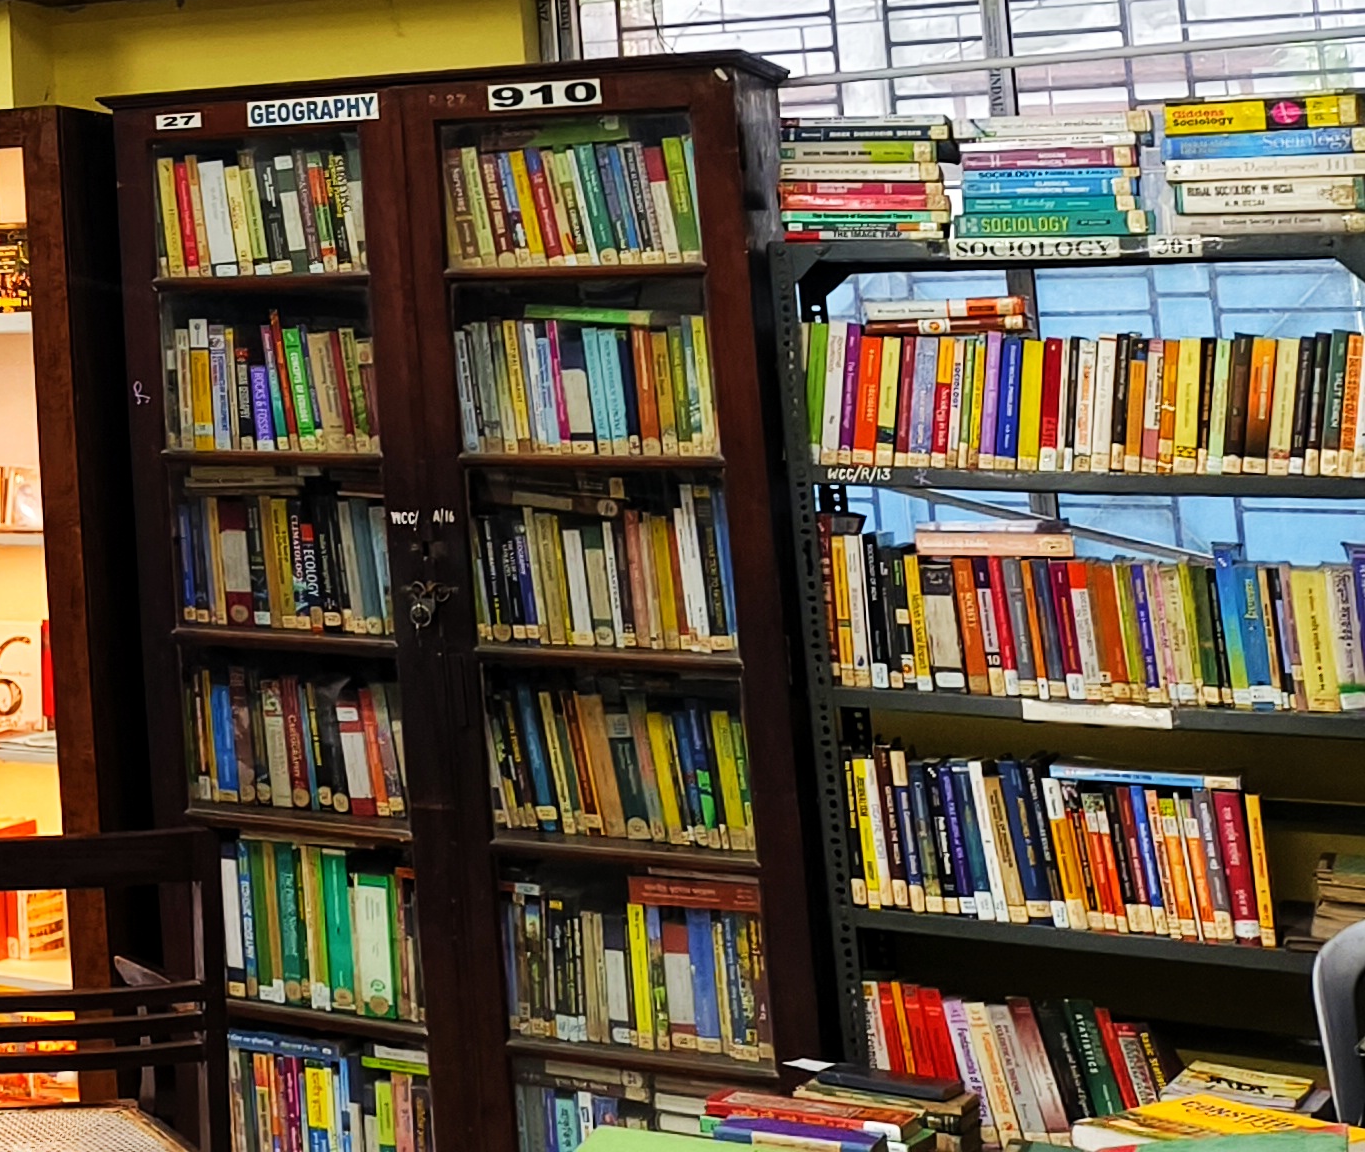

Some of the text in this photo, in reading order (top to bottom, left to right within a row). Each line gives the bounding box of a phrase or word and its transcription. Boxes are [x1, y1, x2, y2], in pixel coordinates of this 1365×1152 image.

[492, 83, 596, 106] 910
[162, 115, 195, 127] 27
[251, 97, 375, 124] GEOGRAPHY
[1172, 108, 1224, 118] Giddens
[1173, 117, 1233, 127] Sociology
[1262, 132, 1351, 148] Sociology
[978, 171, 1037, 179] SOCIOLOGY
[1214, 185, 1256, 196] SOCIOLOGY
[981, 216, 1068, 233] SOCIOLOGY
[1249, 218, 1275, 226] Society
[955, 240, 1111, 257] SOCIOLOGY
[253, 372, 266, 399] ROCKS
[289, 352, 309, 423] CONCEPTS OF ECOLOGY
[951, 362, 961, 409] SOCIOLOGY
[935, 387, 950, 422] Sociology
[1330, 372, 1343, 428] DALIT WOMEN
[256, 408, 271, 440] FOSSILS
[1042, 417, 1056, 448] CASTE
[937, 430, 946, 446] India
[827, 465, 892, 483] WCC/R/13
[391, 507, 455, 527] WCC/ A/16
[291, 515, 303, 583] CLIMATOLOGY
[866, 544, 875, 577] SOCIOLOGY
[303, 549, 319, 597] ECOLOGY
[870, 586, 878, 601] INDIA
[965, 592, 976, 629] SOCIETY
[987, 655, 1000, 665] 10
[888, 814, 898, 829] AND
[891, 830, 900, 842] THE
[892, 843, 901, 865] MEDIA
[957, 1028, 978, 1075] Fundamentals
[1074, 1014, 1098, 1075] STATISTICS
[1140, 1032, 1157, 1056] Basic
[981, 1032, 1011, 1114] Fundamentals of Statistics
